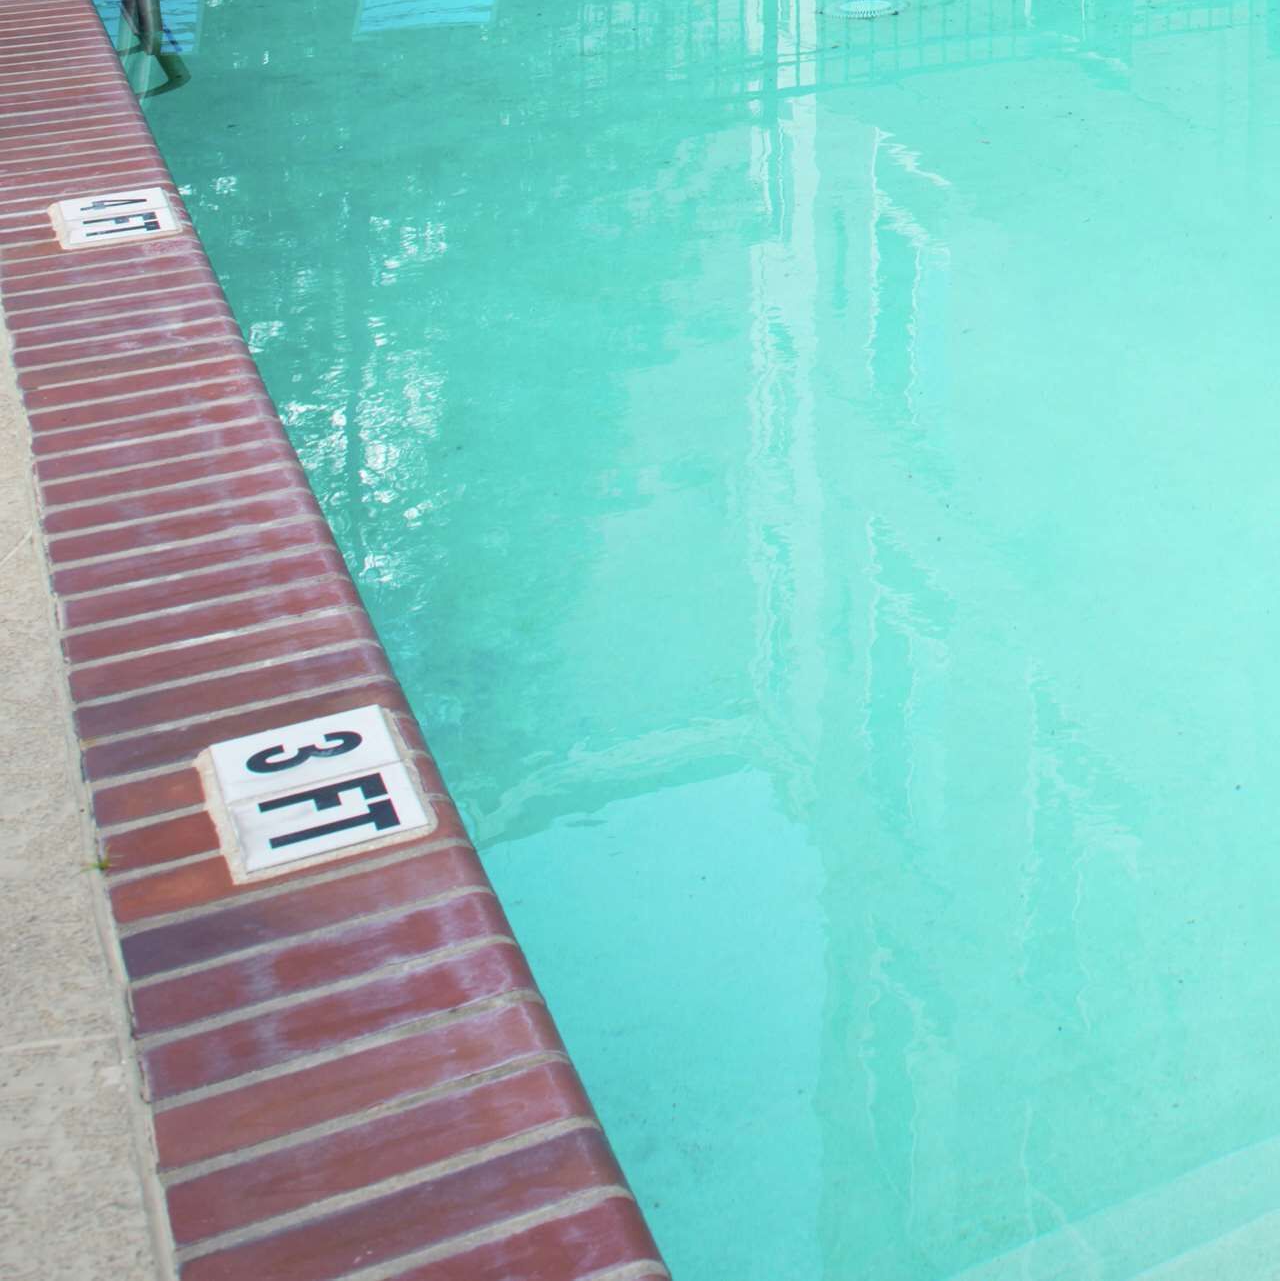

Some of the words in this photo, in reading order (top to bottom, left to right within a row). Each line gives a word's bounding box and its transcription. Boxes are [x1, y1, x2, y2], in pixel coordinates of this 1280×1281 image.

[80, 199, 147, 211] 4
[83, 212, 160, 237] FT
[246, 731, 362, 773] 3
[258, 772, 400, 850] FT
